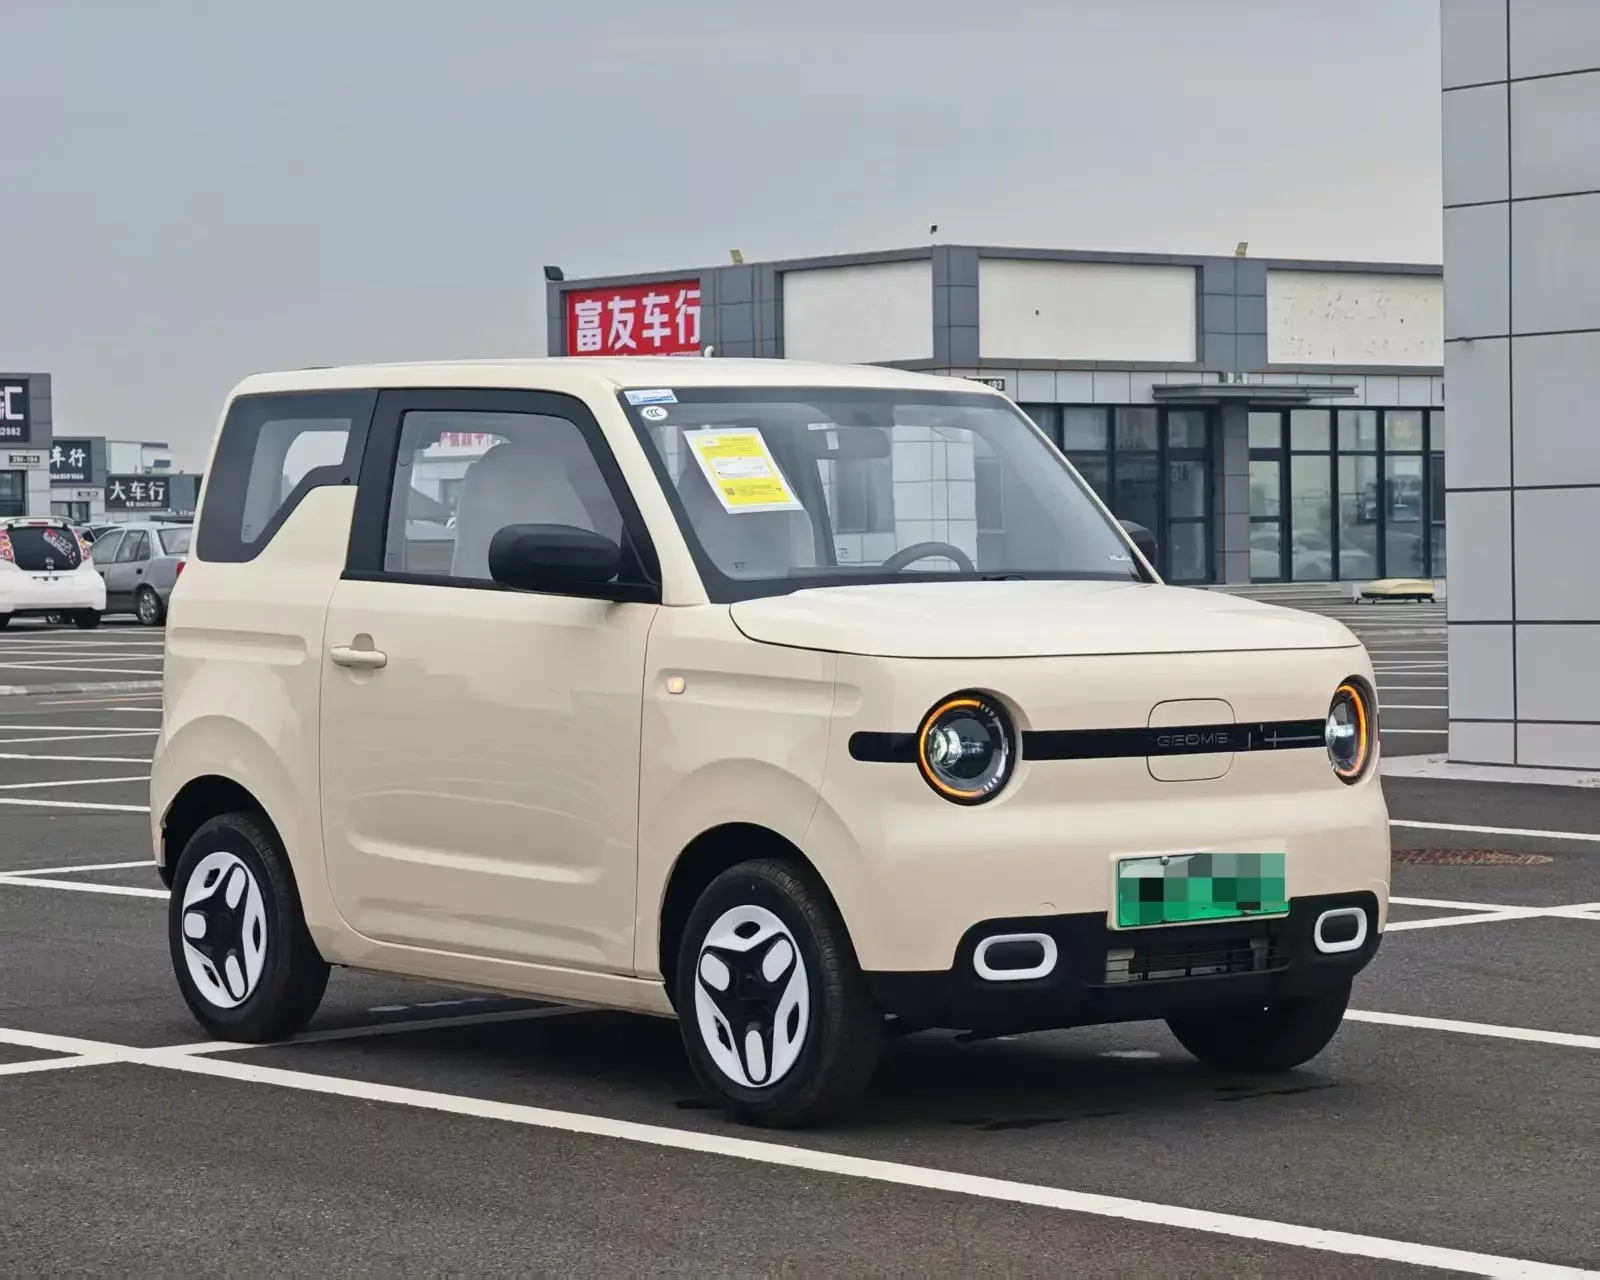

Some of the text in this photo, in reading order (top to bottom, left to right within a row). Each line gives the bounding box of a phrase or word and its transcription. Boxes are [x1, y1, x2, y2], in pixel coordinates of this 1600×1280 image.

[575, 289, 700, 352] 富友车行
[50, 445, 85, 468] 车行
[110, 481, 164, 500] 大车行
[1157, 732, 1229, 747] GEOME
